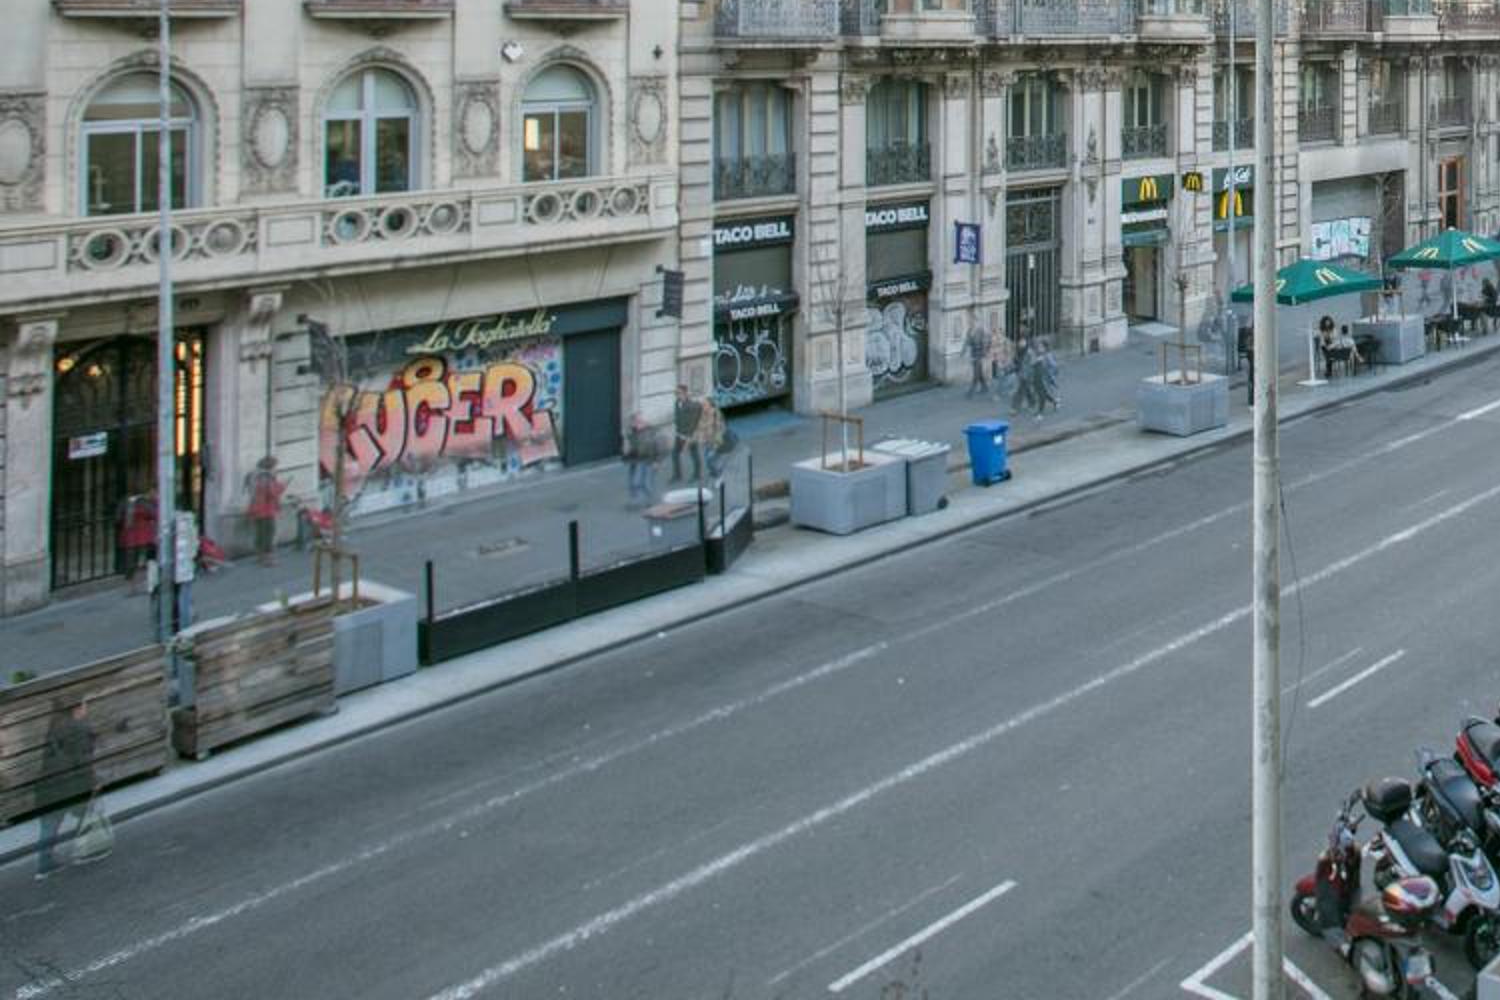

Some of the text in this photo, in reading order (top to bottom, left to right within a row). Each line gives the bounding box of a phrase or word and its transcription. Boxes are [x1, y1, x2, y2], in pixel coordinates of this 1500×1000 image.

[865, 206, 929, 226] TACO BELL
[714, 222, 791, 245] TACO BELL
[731, 303, 781, 318] TACO BELL
[406, 324, 449, 355] La
